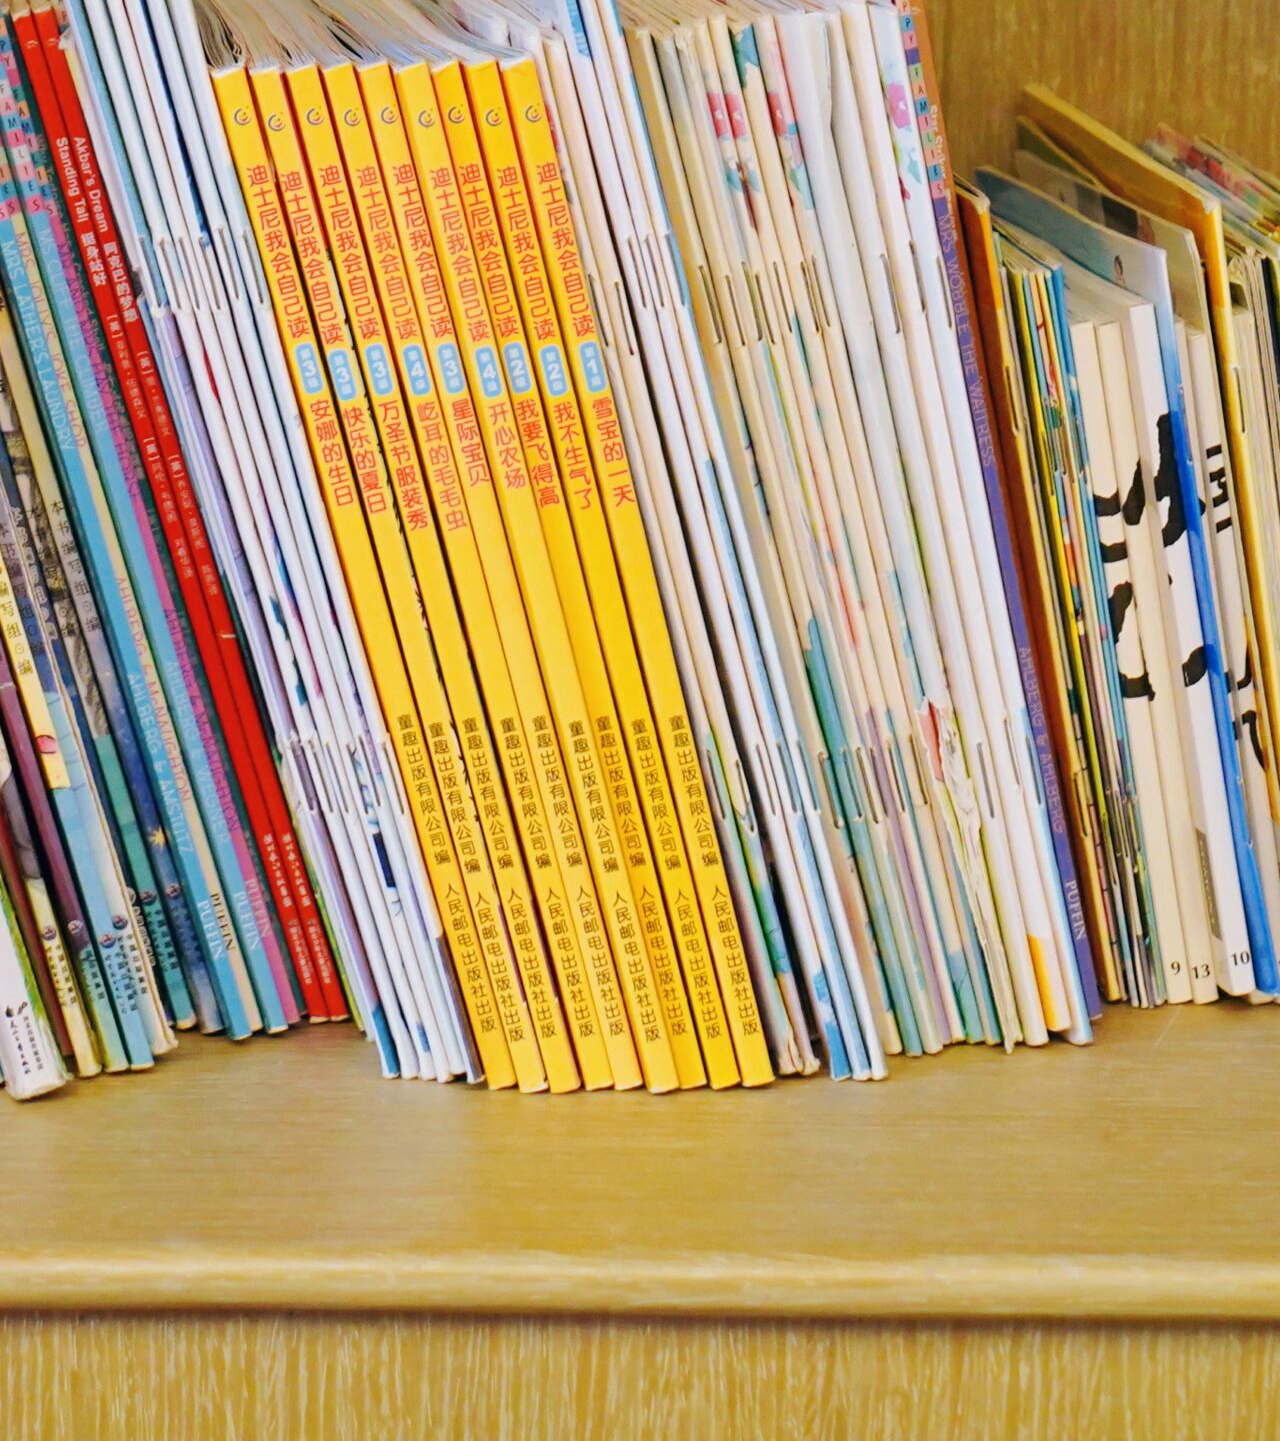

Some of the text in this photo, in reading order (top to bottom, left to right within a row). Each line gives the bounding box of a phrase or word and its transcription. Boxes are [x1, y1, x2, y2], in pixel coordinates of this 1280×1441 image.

[0, 84, 41, 212] FAMILIES
[53, 136, 90, 223] Standing Tall
[71, 134, 111, 232] Akbar's Dream
[914, 66, 943, 194] FAMILIES
[939, 214, 954, 253] MRS
[0, 239, 75, 452] MRS LATHER'S LAUNDRY
[64, 318, 81, 349] THE
[74, 354, 107, 434] CLIMBER
[246, 164, 311, 340] 迪士尼我会自己读
[310, 399, 354, 507] 安娜的生日
[281, 171, 343, 346] 迪士尼我会自己读
[343, 406, 388, 514] 快乐的夏日
[319, 164, 380, 340] 迪士尼我会自己读
[377, 399, 428, 531] 万圣节服装秀
[355, 165, 418, 340] 迪士尼我会自己读
[417, 399, 468, 532] 屹耳的毛毛虫
[392, 162, 452, 339] 迪士尼我会自己读
[451, 399, 489, 488] 星际宝贝
[430, 166, 491, 342] 迪士尼我会自己读
[489, 404, 526, 490] 开心农场
[459, 163, 520, 339] 迪士尼我会自己读
[518, 397, 560, 508] 我要飞得高
[497, 165, 557, 341] 迪士尼我会自己读
[554, 403, 595, 510] 我不生气了
[536, 161, 596, 336] 迪士尼我会自己读
[593, 397, 636, 506] 雪宝的一天
[944, 256, 971, 335] WOBBLE
[961, 342, 979, 375] THE
[970, 380, 994, 466] WAITRESS
[126, 672, 161, 754] AHLBERG
[158, 777, 192, 856] AMSTUTZ
[197, 899, 225, 961] PUFFIN
[164, 659, 198, 742] AHLBERG
[237, 890, 262, 949] PUFFIN
[244, 877, 273, 938] PUFFIN
[397, 714, 496, 1034] 童趣出版有限公司编 人民邮电出版社出版
[428, 721, 525, 1042] 童趣出版有限公司编 人民邮电出版社出版
[462, 717, 557, 1039] 童趣出版有限公司编 人民邮电出版社出版
[499, 717, 595, 1038] 童趣出版有限公司编 人民邮电出版社出版
[532, 716, 625, 1036] 童趣出版有限公司编 人民邮电出版社出版
[568, 720, 661, 1042] 童趣出版有限公司编 人民邮电出版社出版
[595, 715, 688, 1037] 童趣出版有限公司编 人民邮电出版社出版
[631, 718, 723, 1040] 童趣出版有限公司编 人民邮电出版社出版
[669, 714, 760, 1036] 童趣出版有限公司编 人民邮电出版社出版
[1018, 645, 1043, 728] AHLBERG
[1039, 752, 1066, 834] AHLBERG
[1065, 879, 1087, 940] PUFFIN
[1171, 961, 1181, 976] 9
[1192, 964, 1211, 979] 13
[1230, 950, 1250, 966] 10
